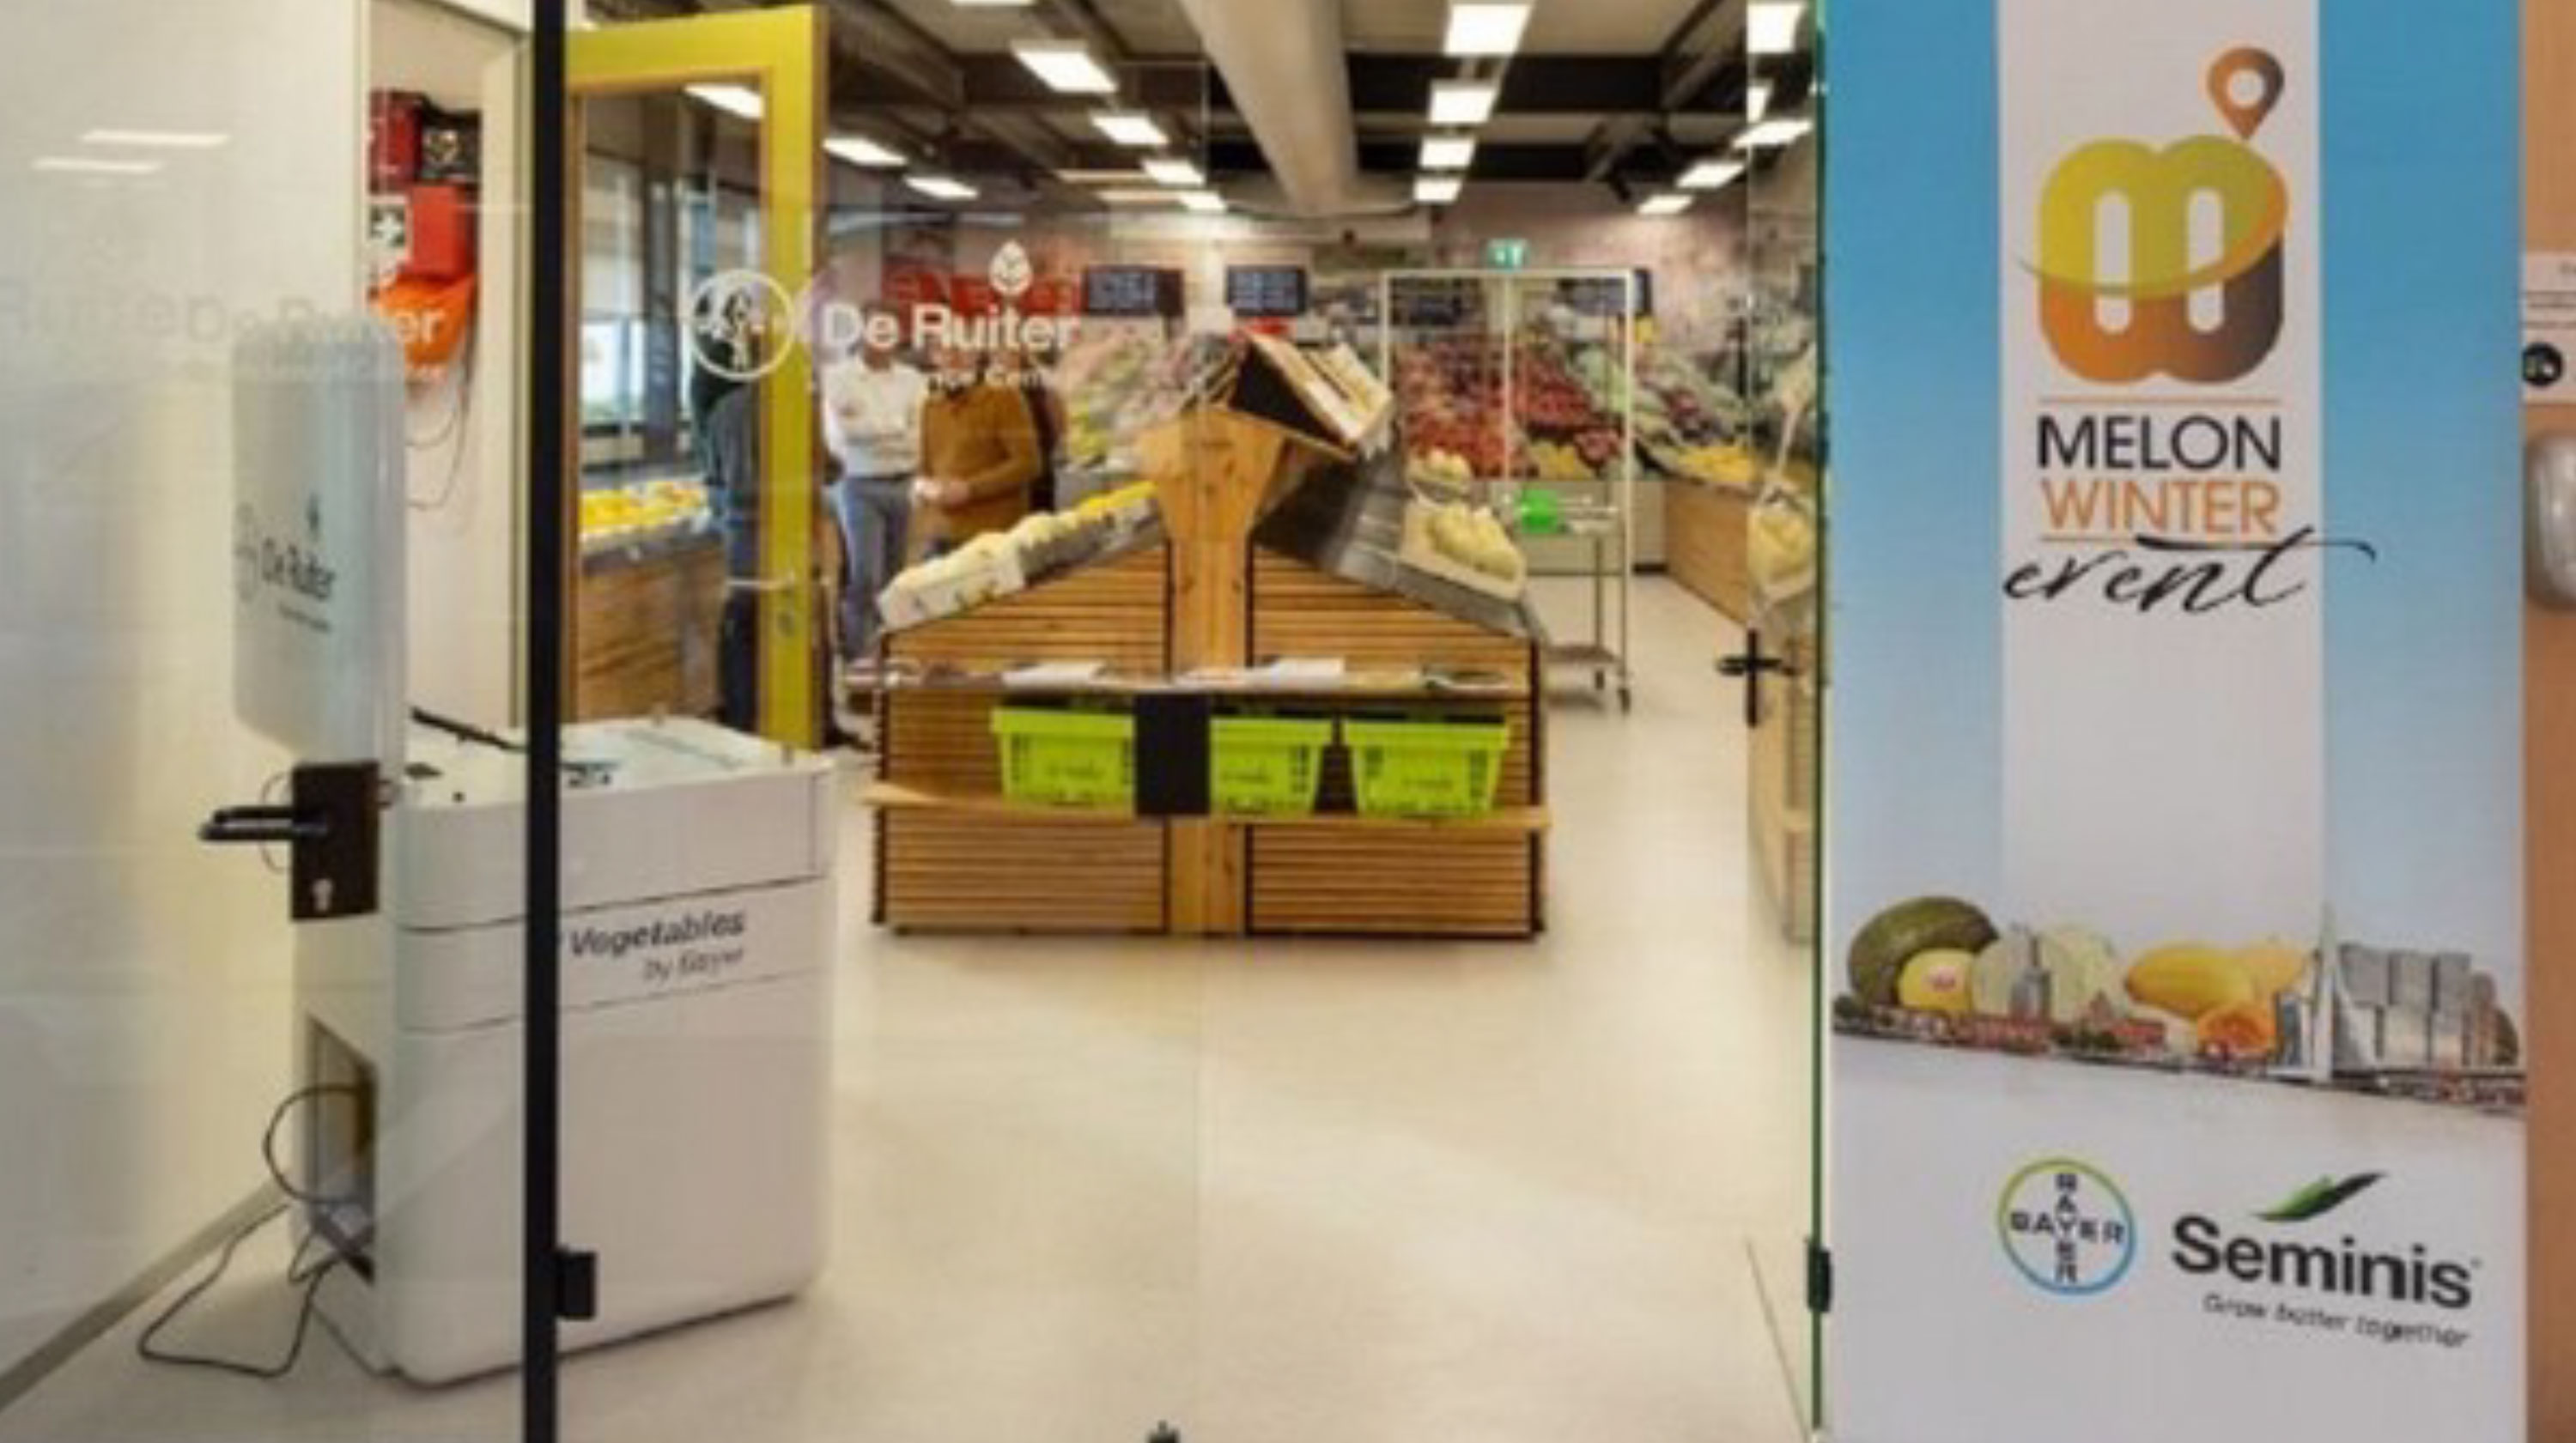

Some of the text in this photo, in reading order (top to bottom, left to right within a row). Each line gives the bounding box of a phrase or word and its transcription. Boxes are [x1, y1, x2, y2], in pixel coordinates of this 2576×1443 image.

[822, 303, 901, 349] De
[913, 304, 1080, 351] Ruiter
[2037, 415, 2282, 470] MELON
[2041, 480, 2281, 534] WINTER
[2002, 525, 2377, 614] event
[569, 910, 744, 958] Vegetables
[2010, 1211, 2125, 1244] BAYER
[2056, 1173, 2077, 1283] BAYER
[2172, 1214, 2472, 1309] Seminis
